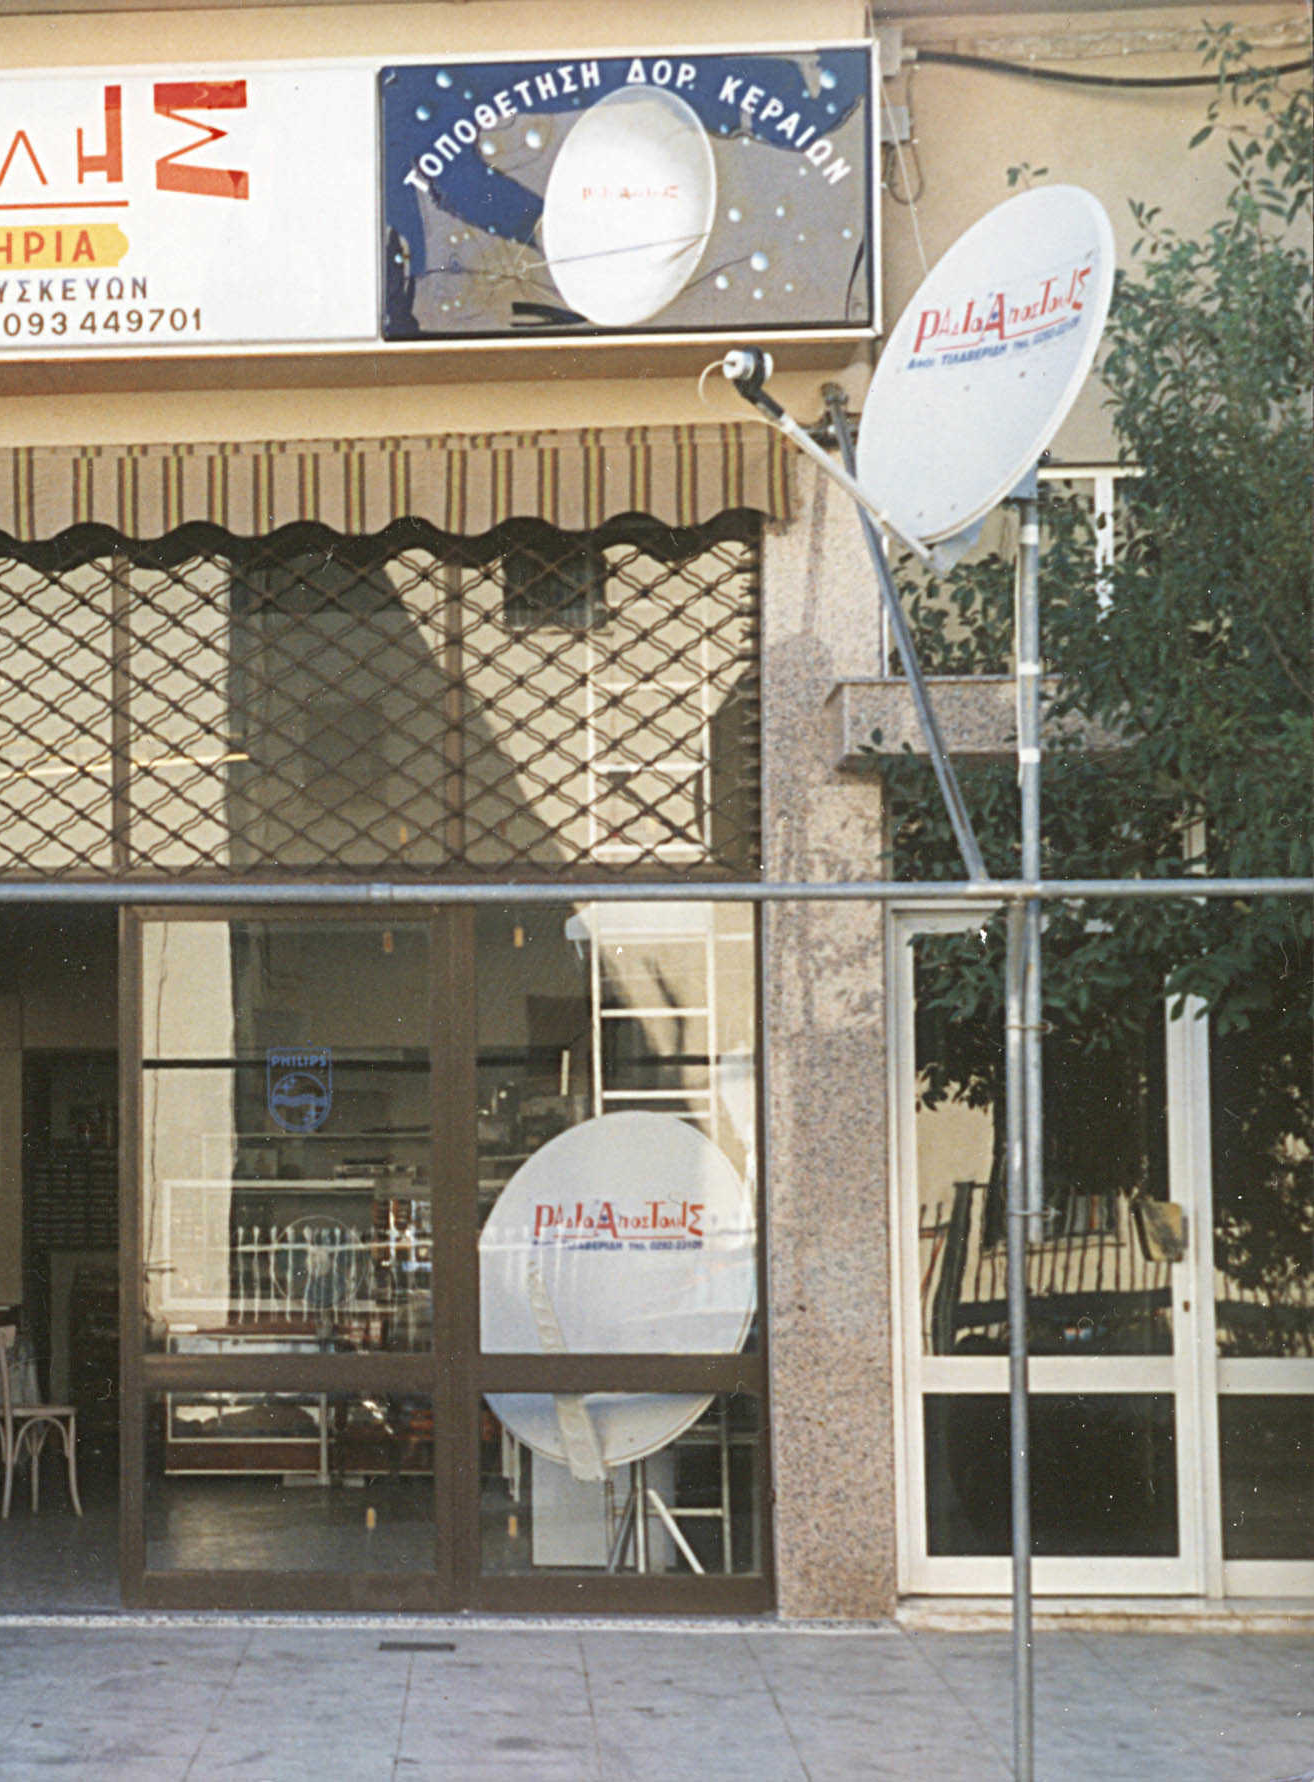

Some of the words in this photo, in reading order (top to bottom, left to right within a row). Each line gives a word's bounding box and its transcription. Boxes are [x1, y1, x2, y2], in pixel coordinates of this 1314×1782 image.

[403, 61, 601, 192] ΤΟΠΟΘΕΤΗΣΗ
[718, 76, 851, 184] ΚΕΡΑΙΩΝ
[270, 1055, 327, 1067] PHILIPS
